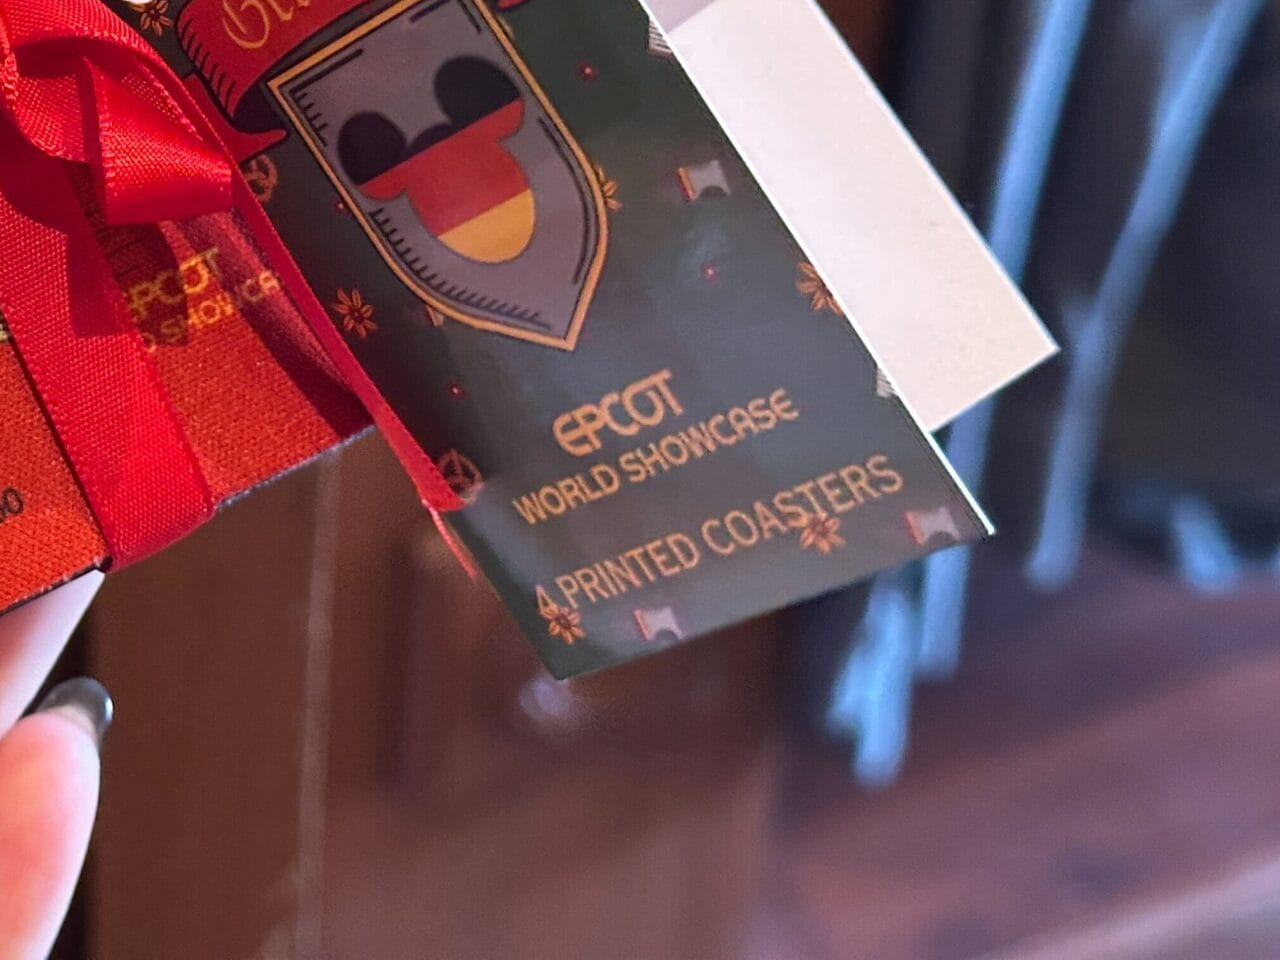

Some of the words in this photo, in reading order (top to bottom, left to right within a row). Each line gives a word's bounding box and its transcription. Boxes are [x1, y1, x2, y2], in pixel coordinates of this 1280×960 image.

[512, 463, 620, 526] WORLD
[619, 387, 800, 483] SHOWCASE
[552, 368, 684, 457] EPCOT
[555, 532, 700, 610] PRINTED
[700, 454, 904, 556] COASTERS
